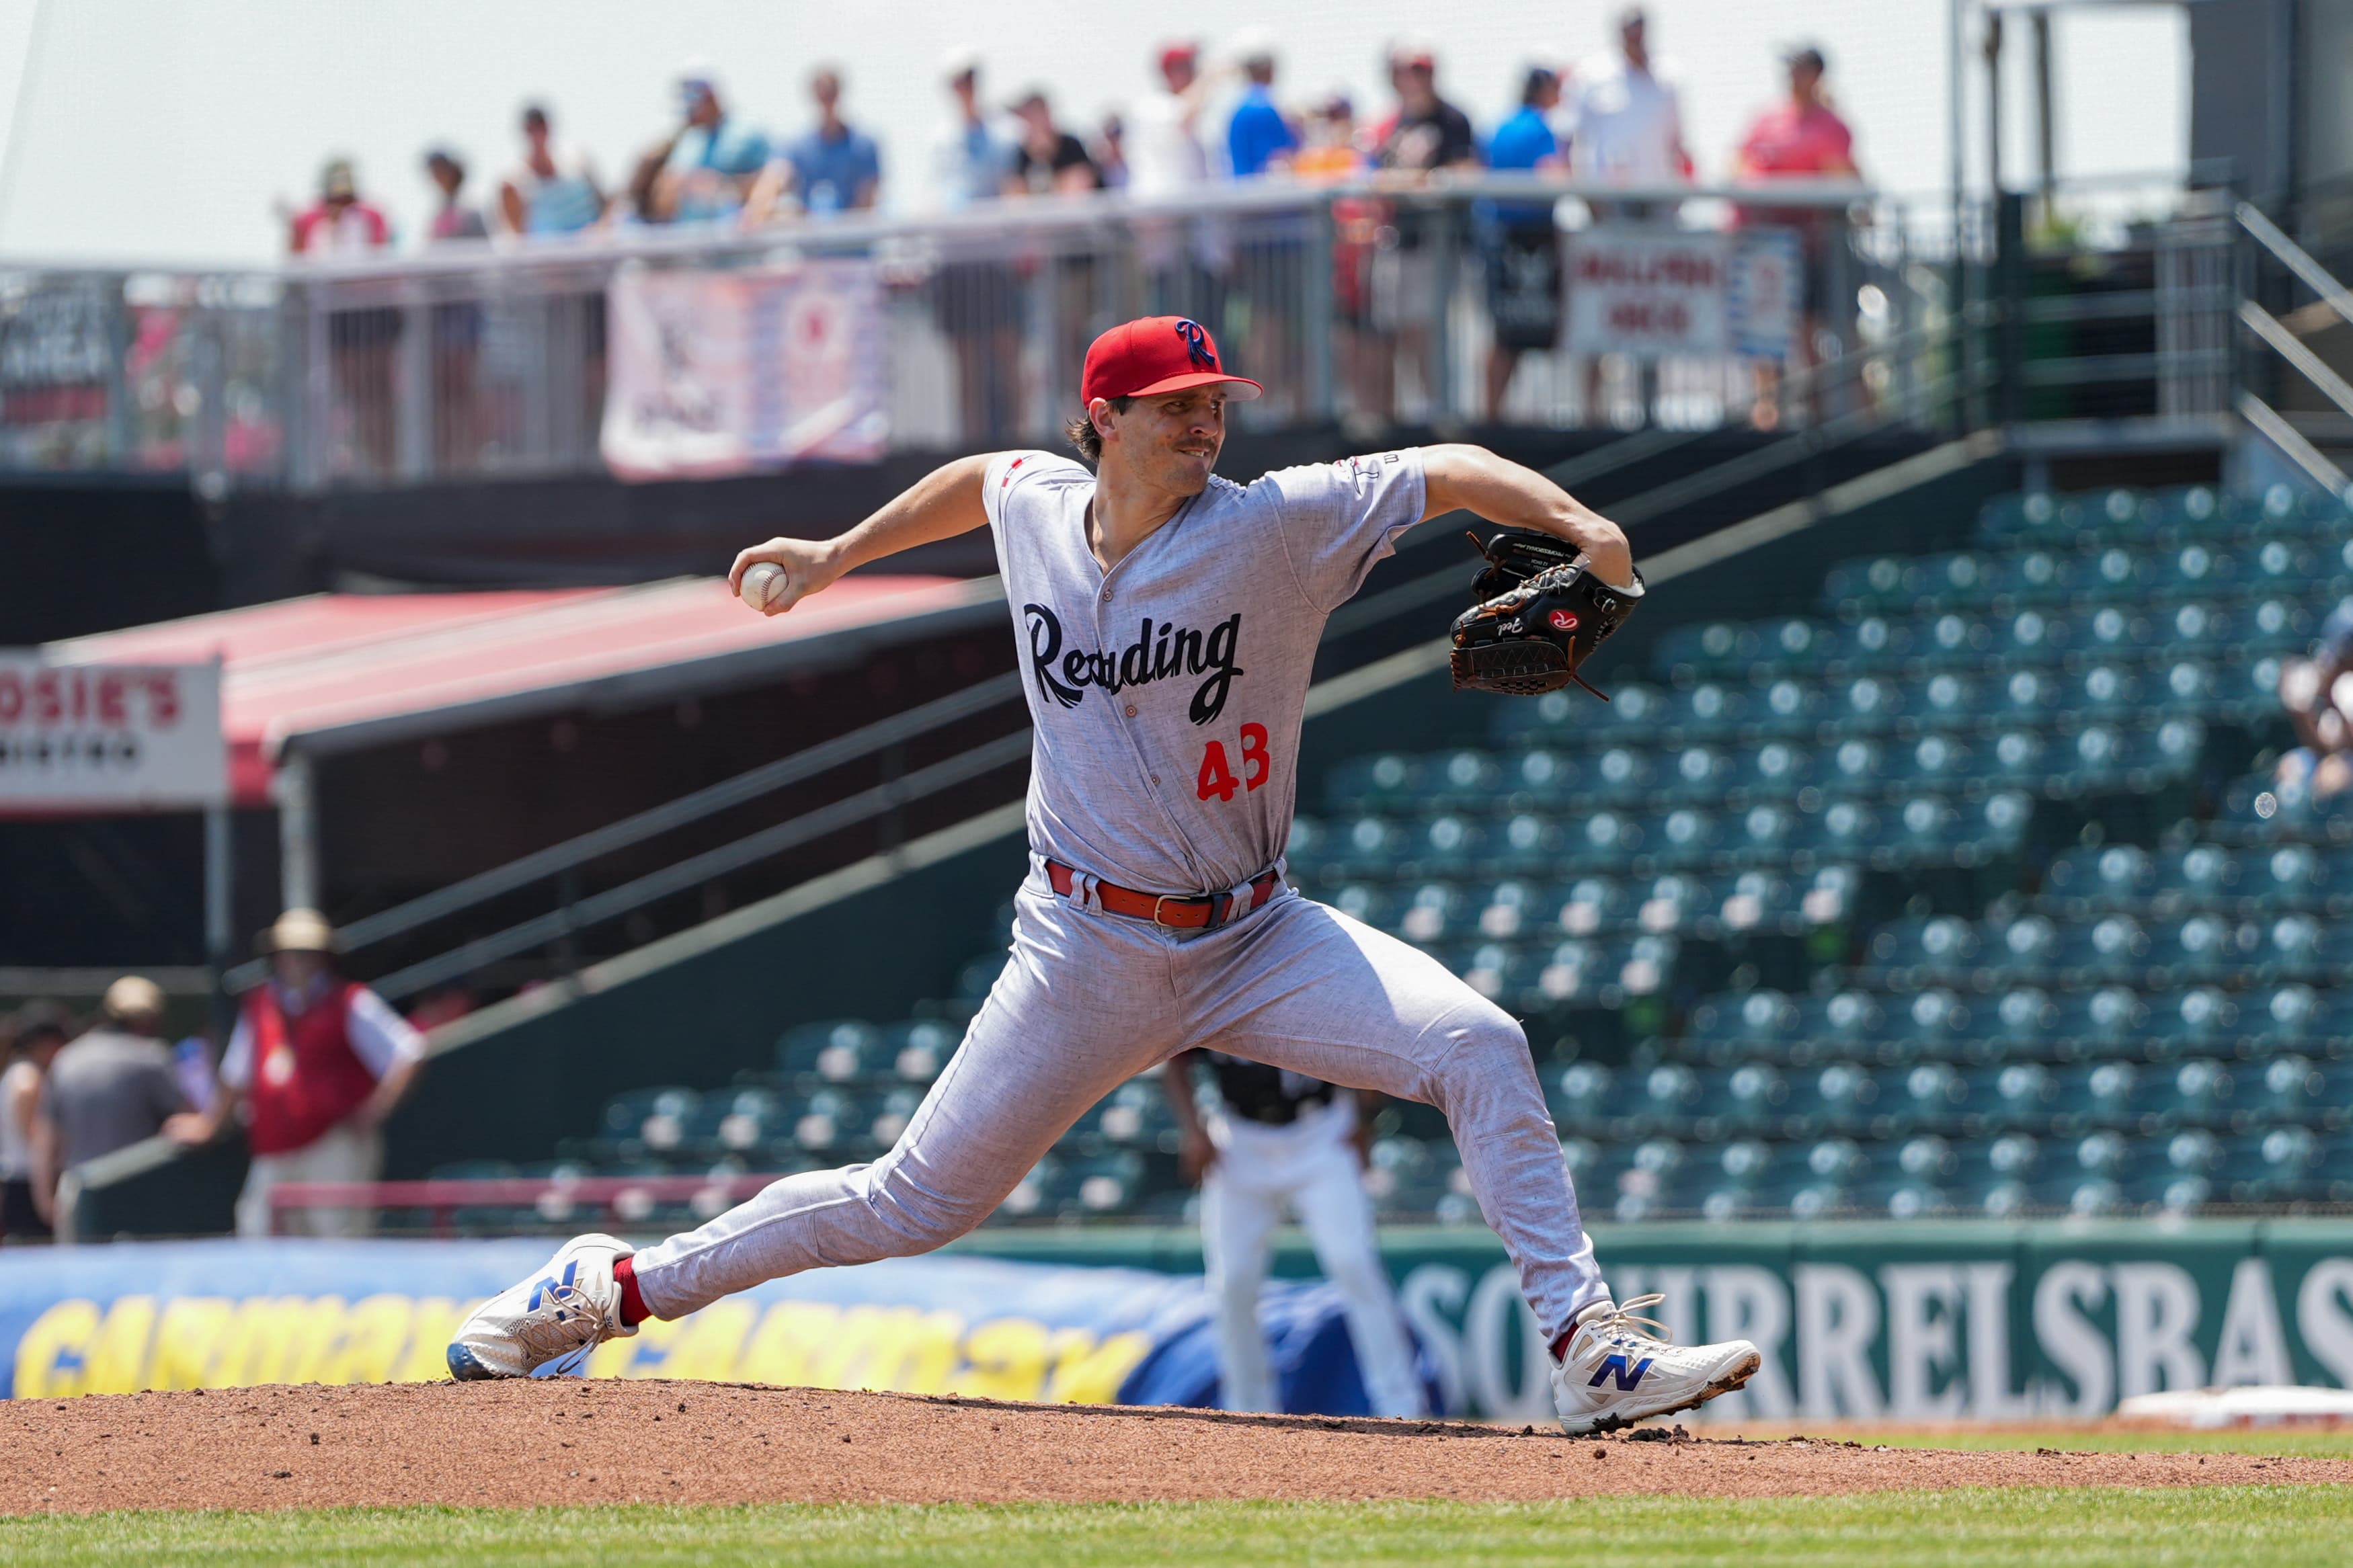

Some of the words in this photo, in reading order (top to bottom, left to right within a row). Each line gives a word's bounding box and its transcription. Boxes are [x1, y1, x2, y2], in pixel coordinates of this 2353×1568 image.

[1174, 319, 1215, 366] R
[1497, 617, 1523, 636] Feel
[1023, 603, 1244, 726] Reading
[1587, 1354, 1655, 1392] N
